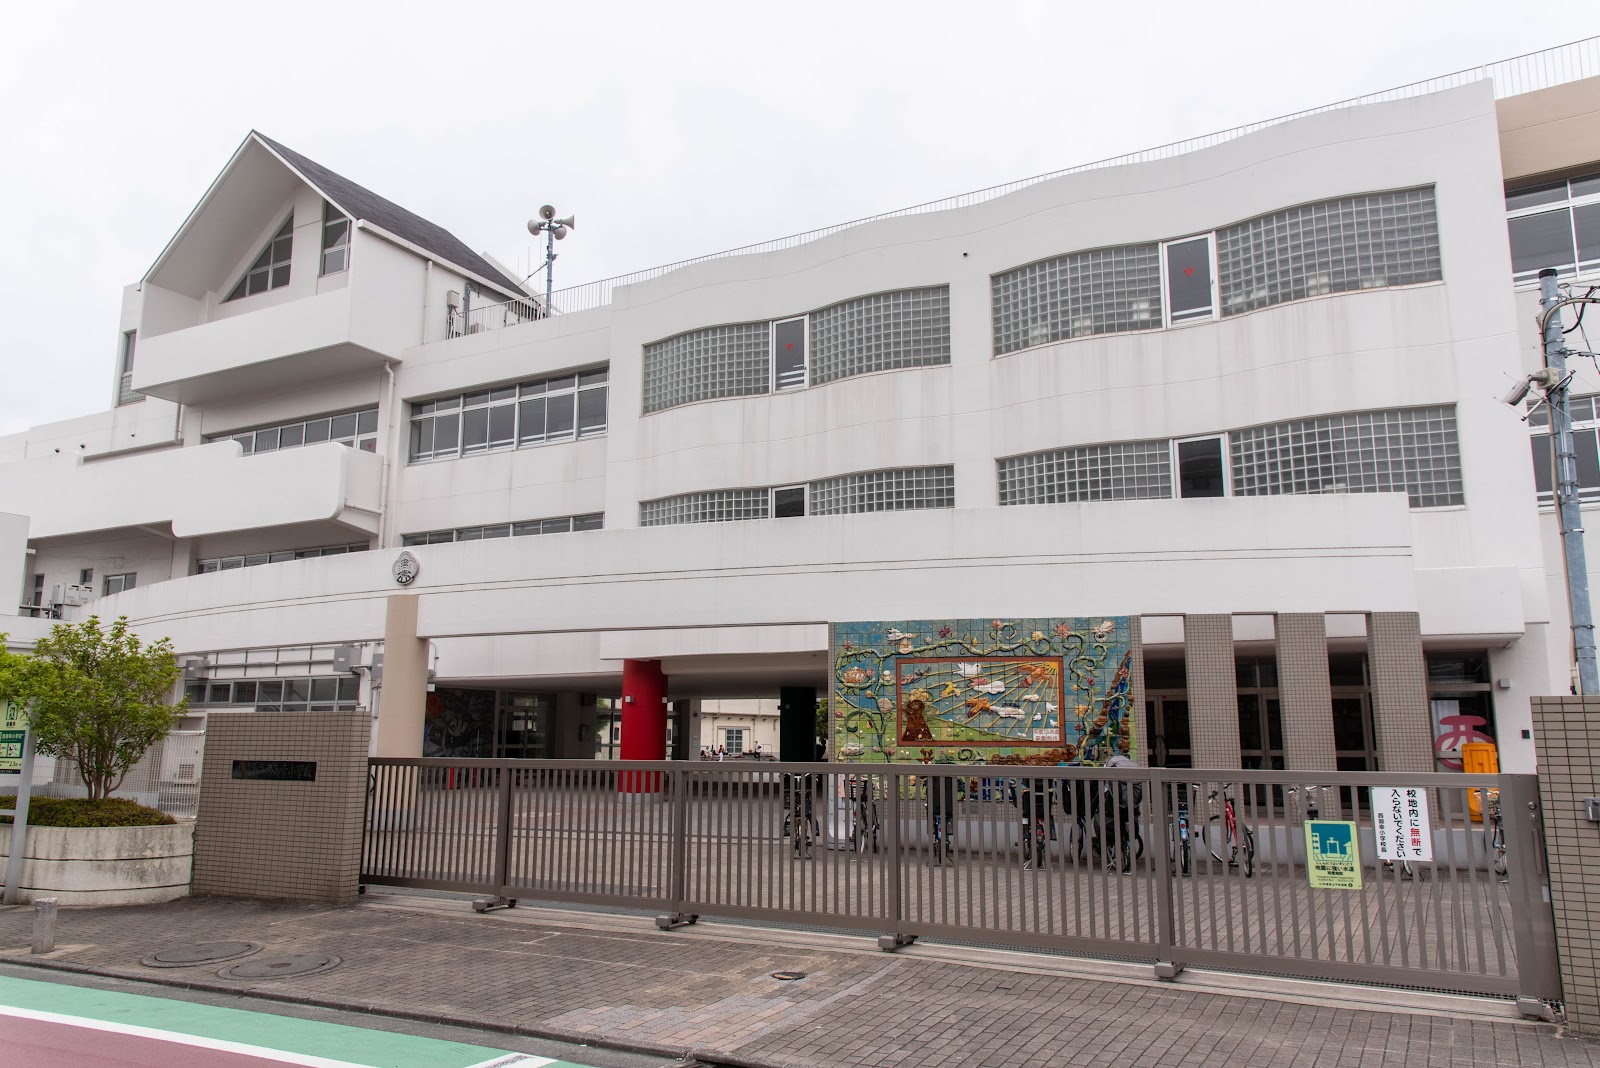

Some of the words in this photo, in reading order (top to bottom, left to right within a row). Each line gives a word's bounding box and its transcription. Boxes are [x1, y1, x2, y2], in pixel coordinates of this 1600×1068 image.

[1377, 812, 1387, 853] 西御幸小学校長
[1391, 789, 1406, 858] 入らないでください
[1406, 789, 1422, 856] 校地内に無断で
